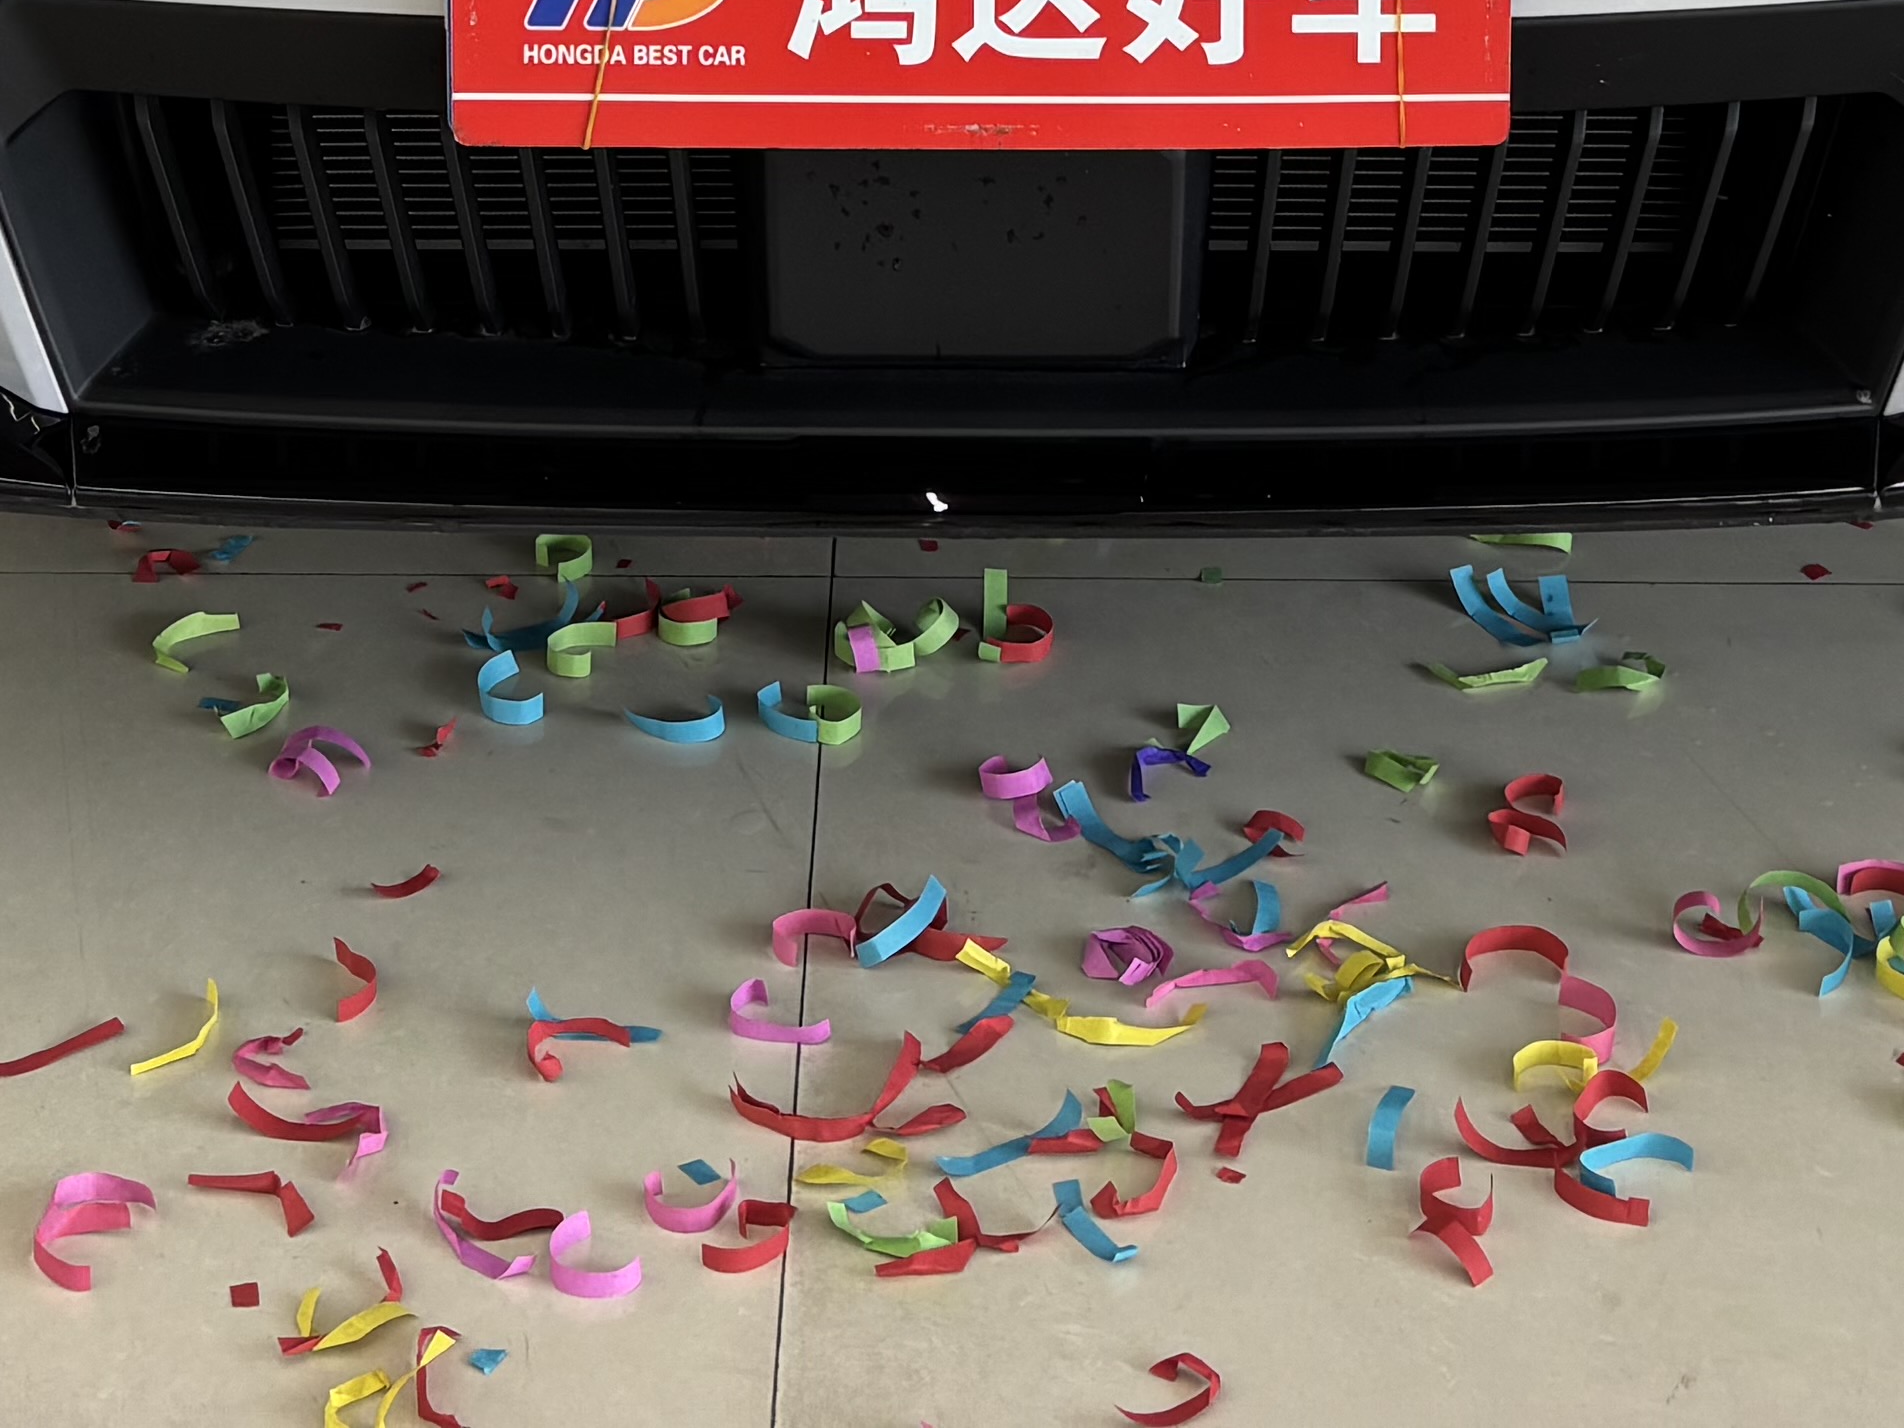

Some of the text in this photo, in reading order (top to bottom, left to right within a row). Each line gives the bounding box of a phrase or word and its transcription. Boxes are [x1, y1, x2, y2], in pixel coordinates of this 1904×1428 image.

[522, 43, 746, 67] HONGDA BEST CAR
